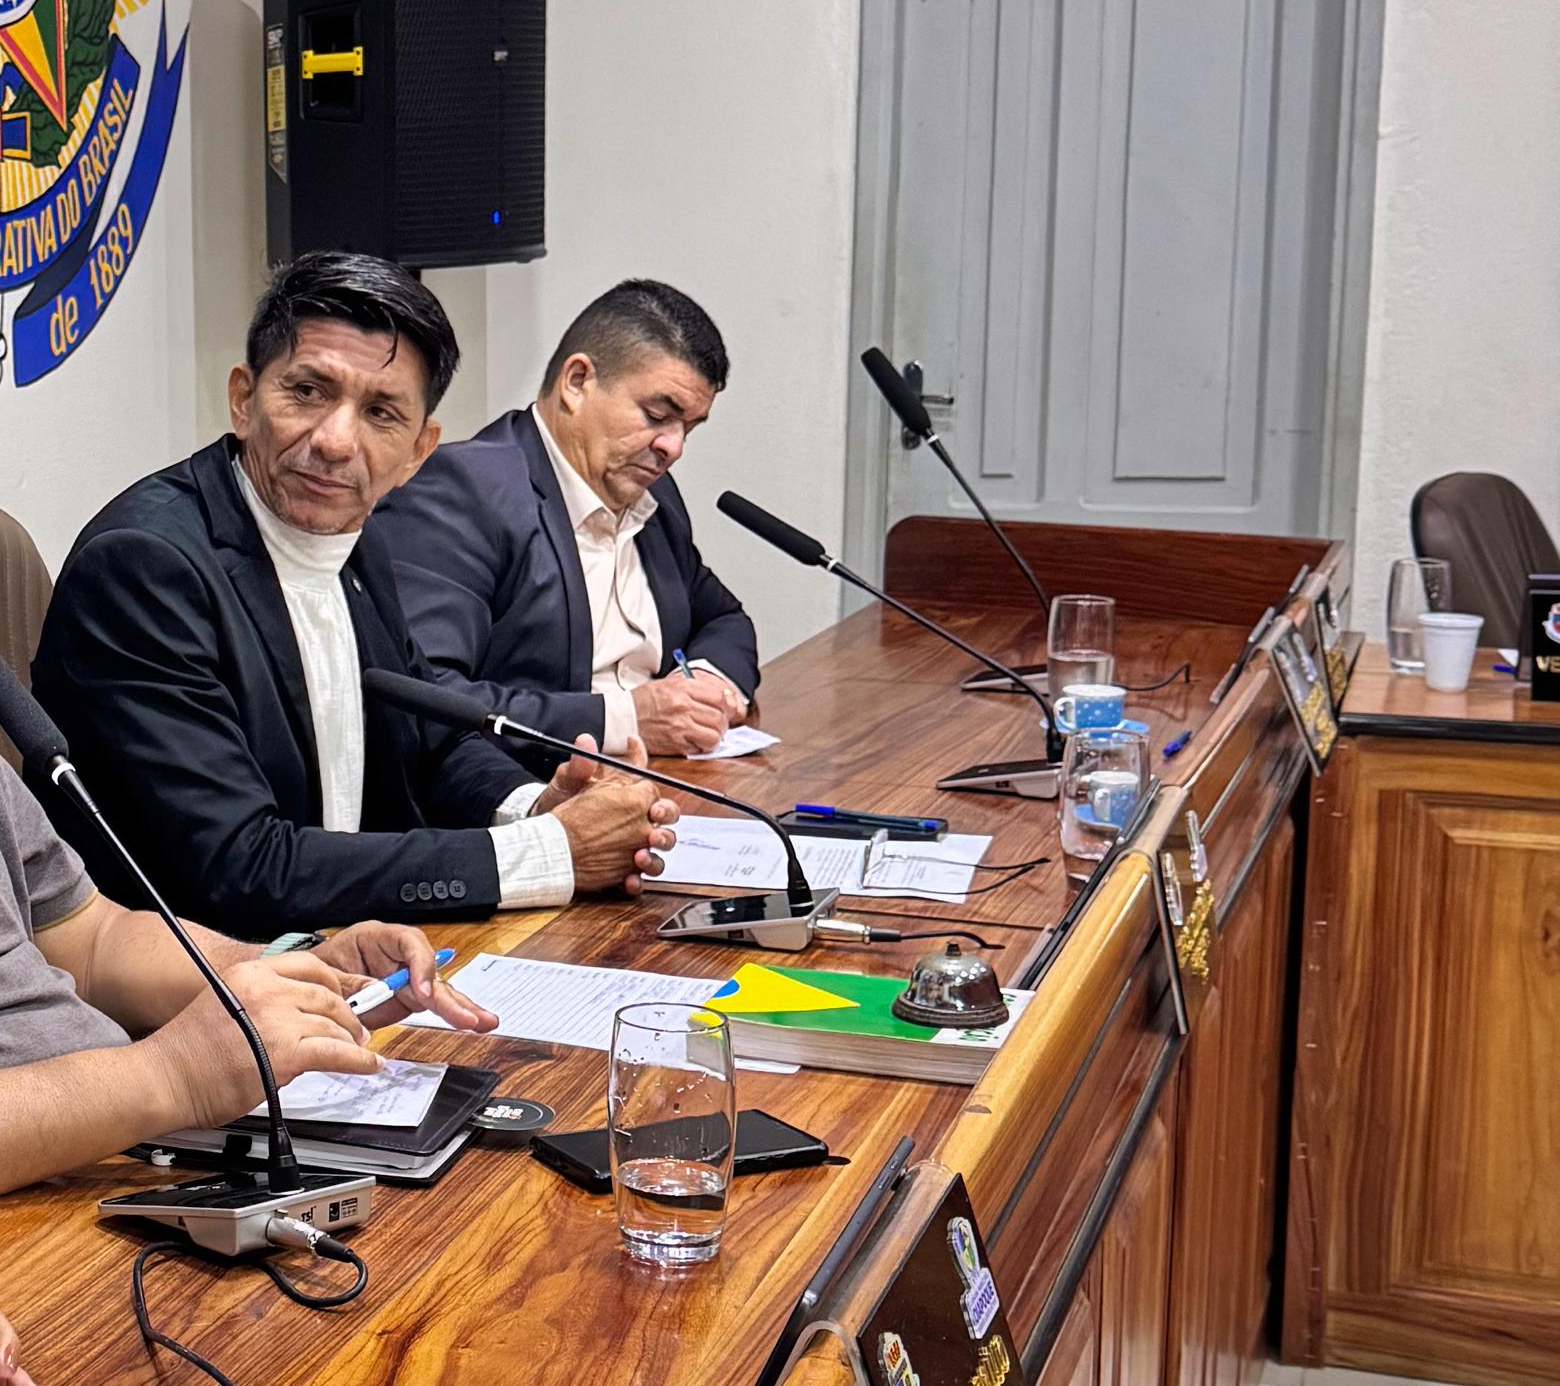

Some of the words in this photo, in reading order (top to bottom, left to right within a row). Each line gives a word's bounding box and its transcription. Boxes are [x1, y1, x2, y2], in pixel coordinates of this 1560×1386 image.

[55, 191, 81, 249] DO
[80, 80, 135, 207] BRASIL
[49, 305, 80, 357] de
[89, 203, 134, 311] 1889
